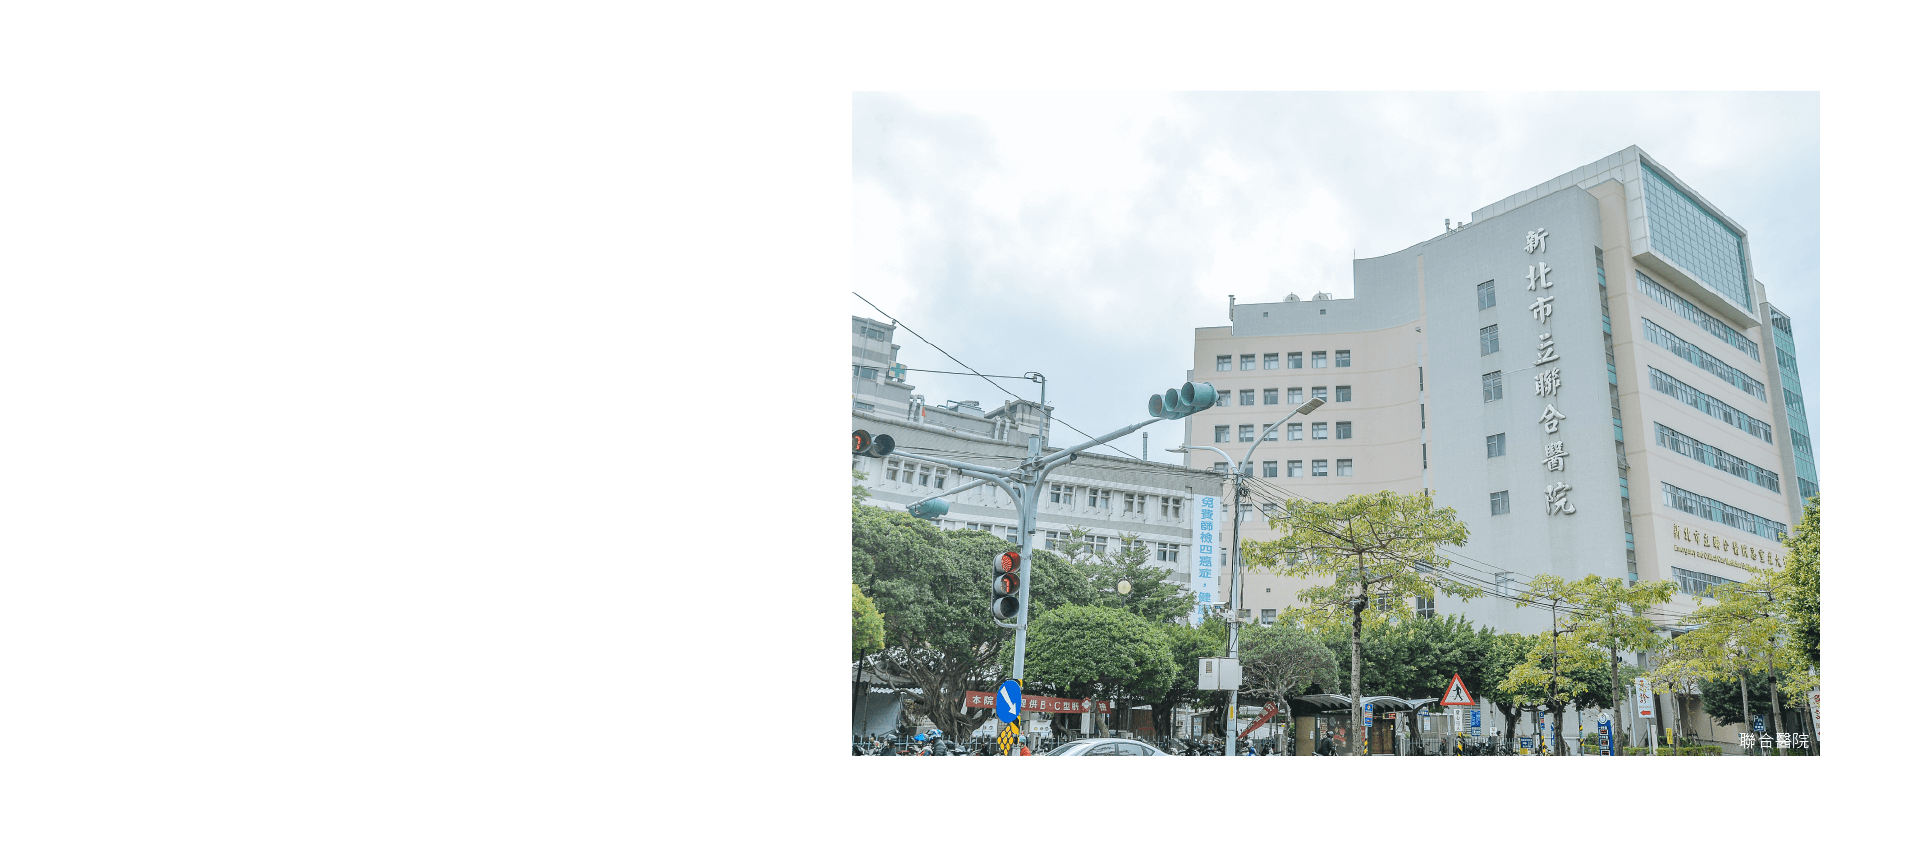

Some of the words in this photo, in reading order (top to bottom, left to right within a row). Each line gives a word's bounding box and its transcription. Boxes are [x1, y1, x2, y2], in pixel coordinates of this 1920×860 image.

[1523, 227, 1576, 516] 新北市立聯合醫院
